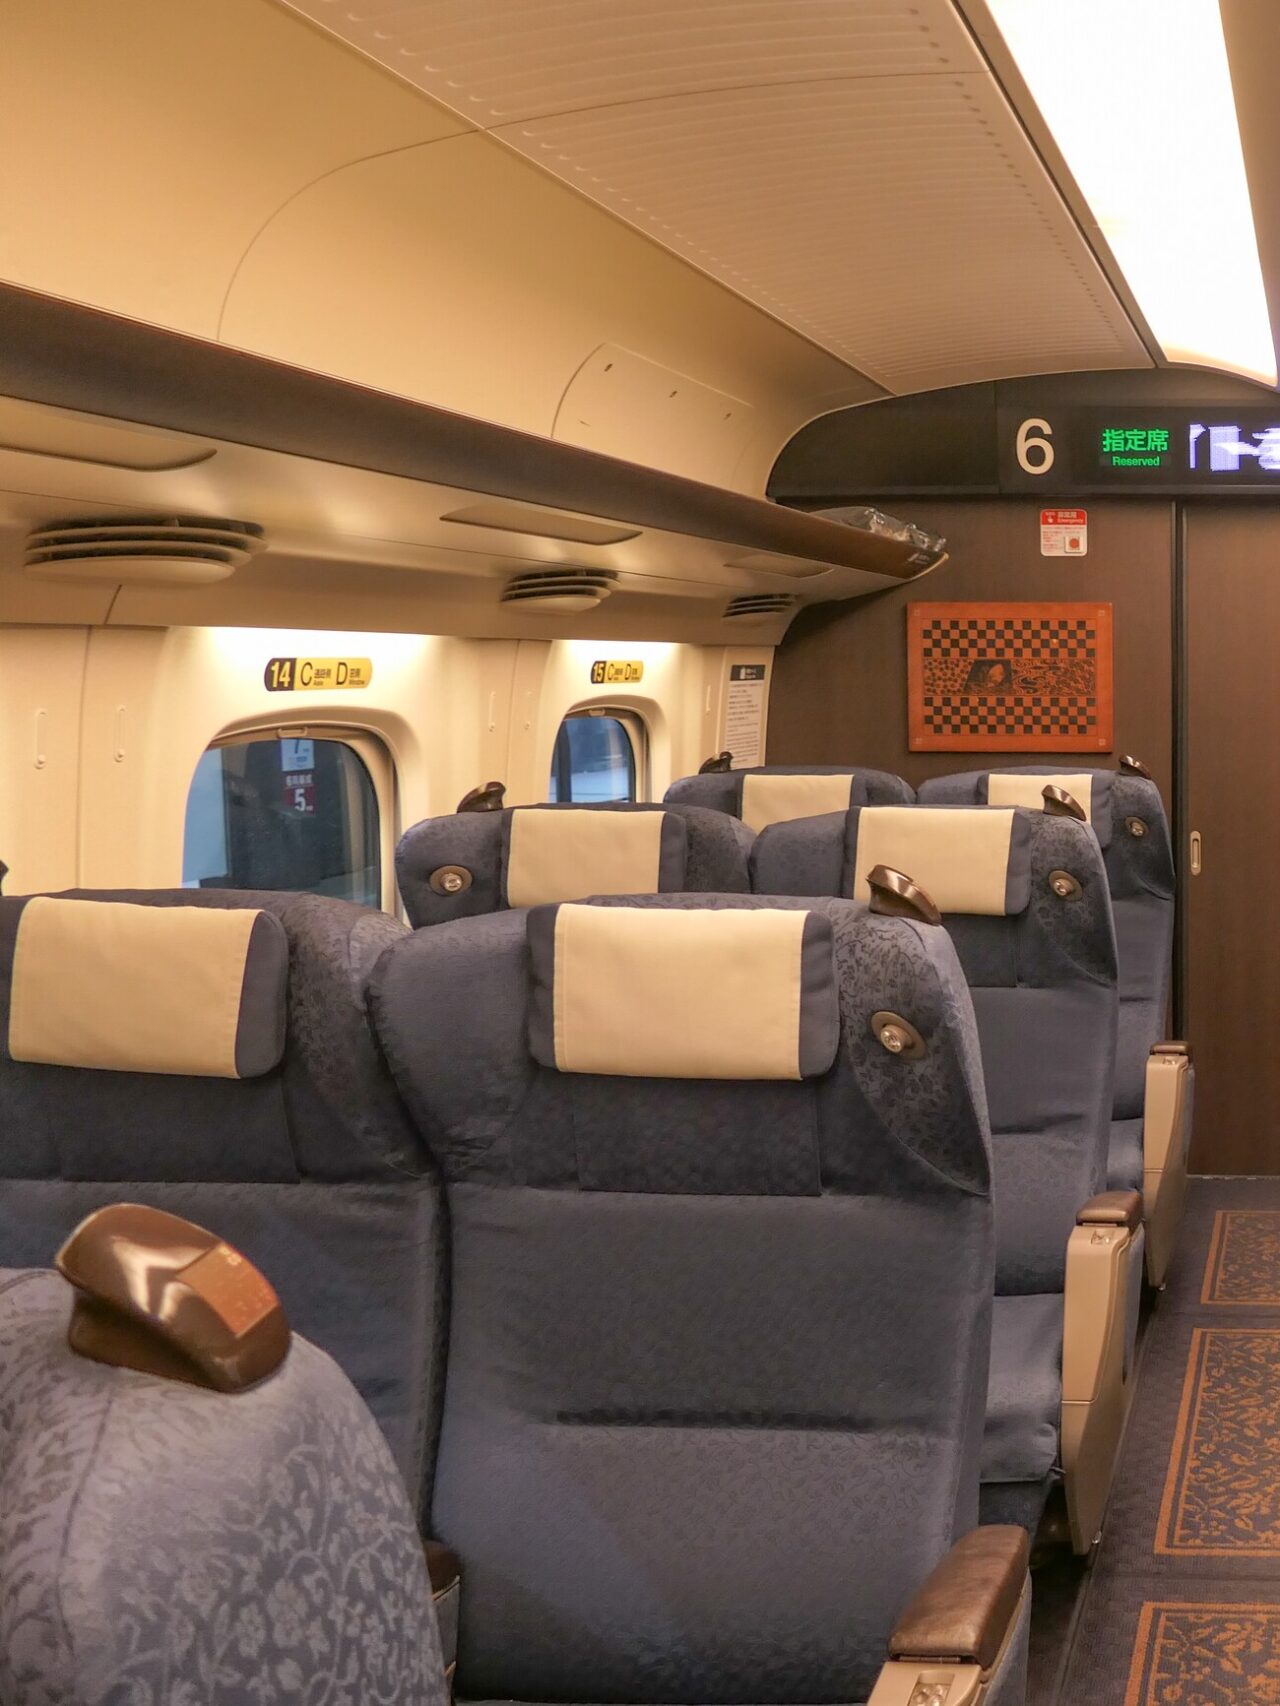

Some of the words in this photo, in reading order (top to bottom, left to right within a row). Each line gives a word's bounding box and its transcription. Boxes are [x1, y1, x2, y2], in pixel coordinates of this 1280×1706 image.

[1016, 418, 1055, 475] 6
[1102, 429, 1169, 452] 指定席
[1112, 456, 1160, 466] Reserved
[271, 661, 292, 688] 14
[300, 662, 313, 686] C
[336, 662, 348, 685] D
[594, 663, 605, 682] 15
[294, 788, 306, 811] 5
